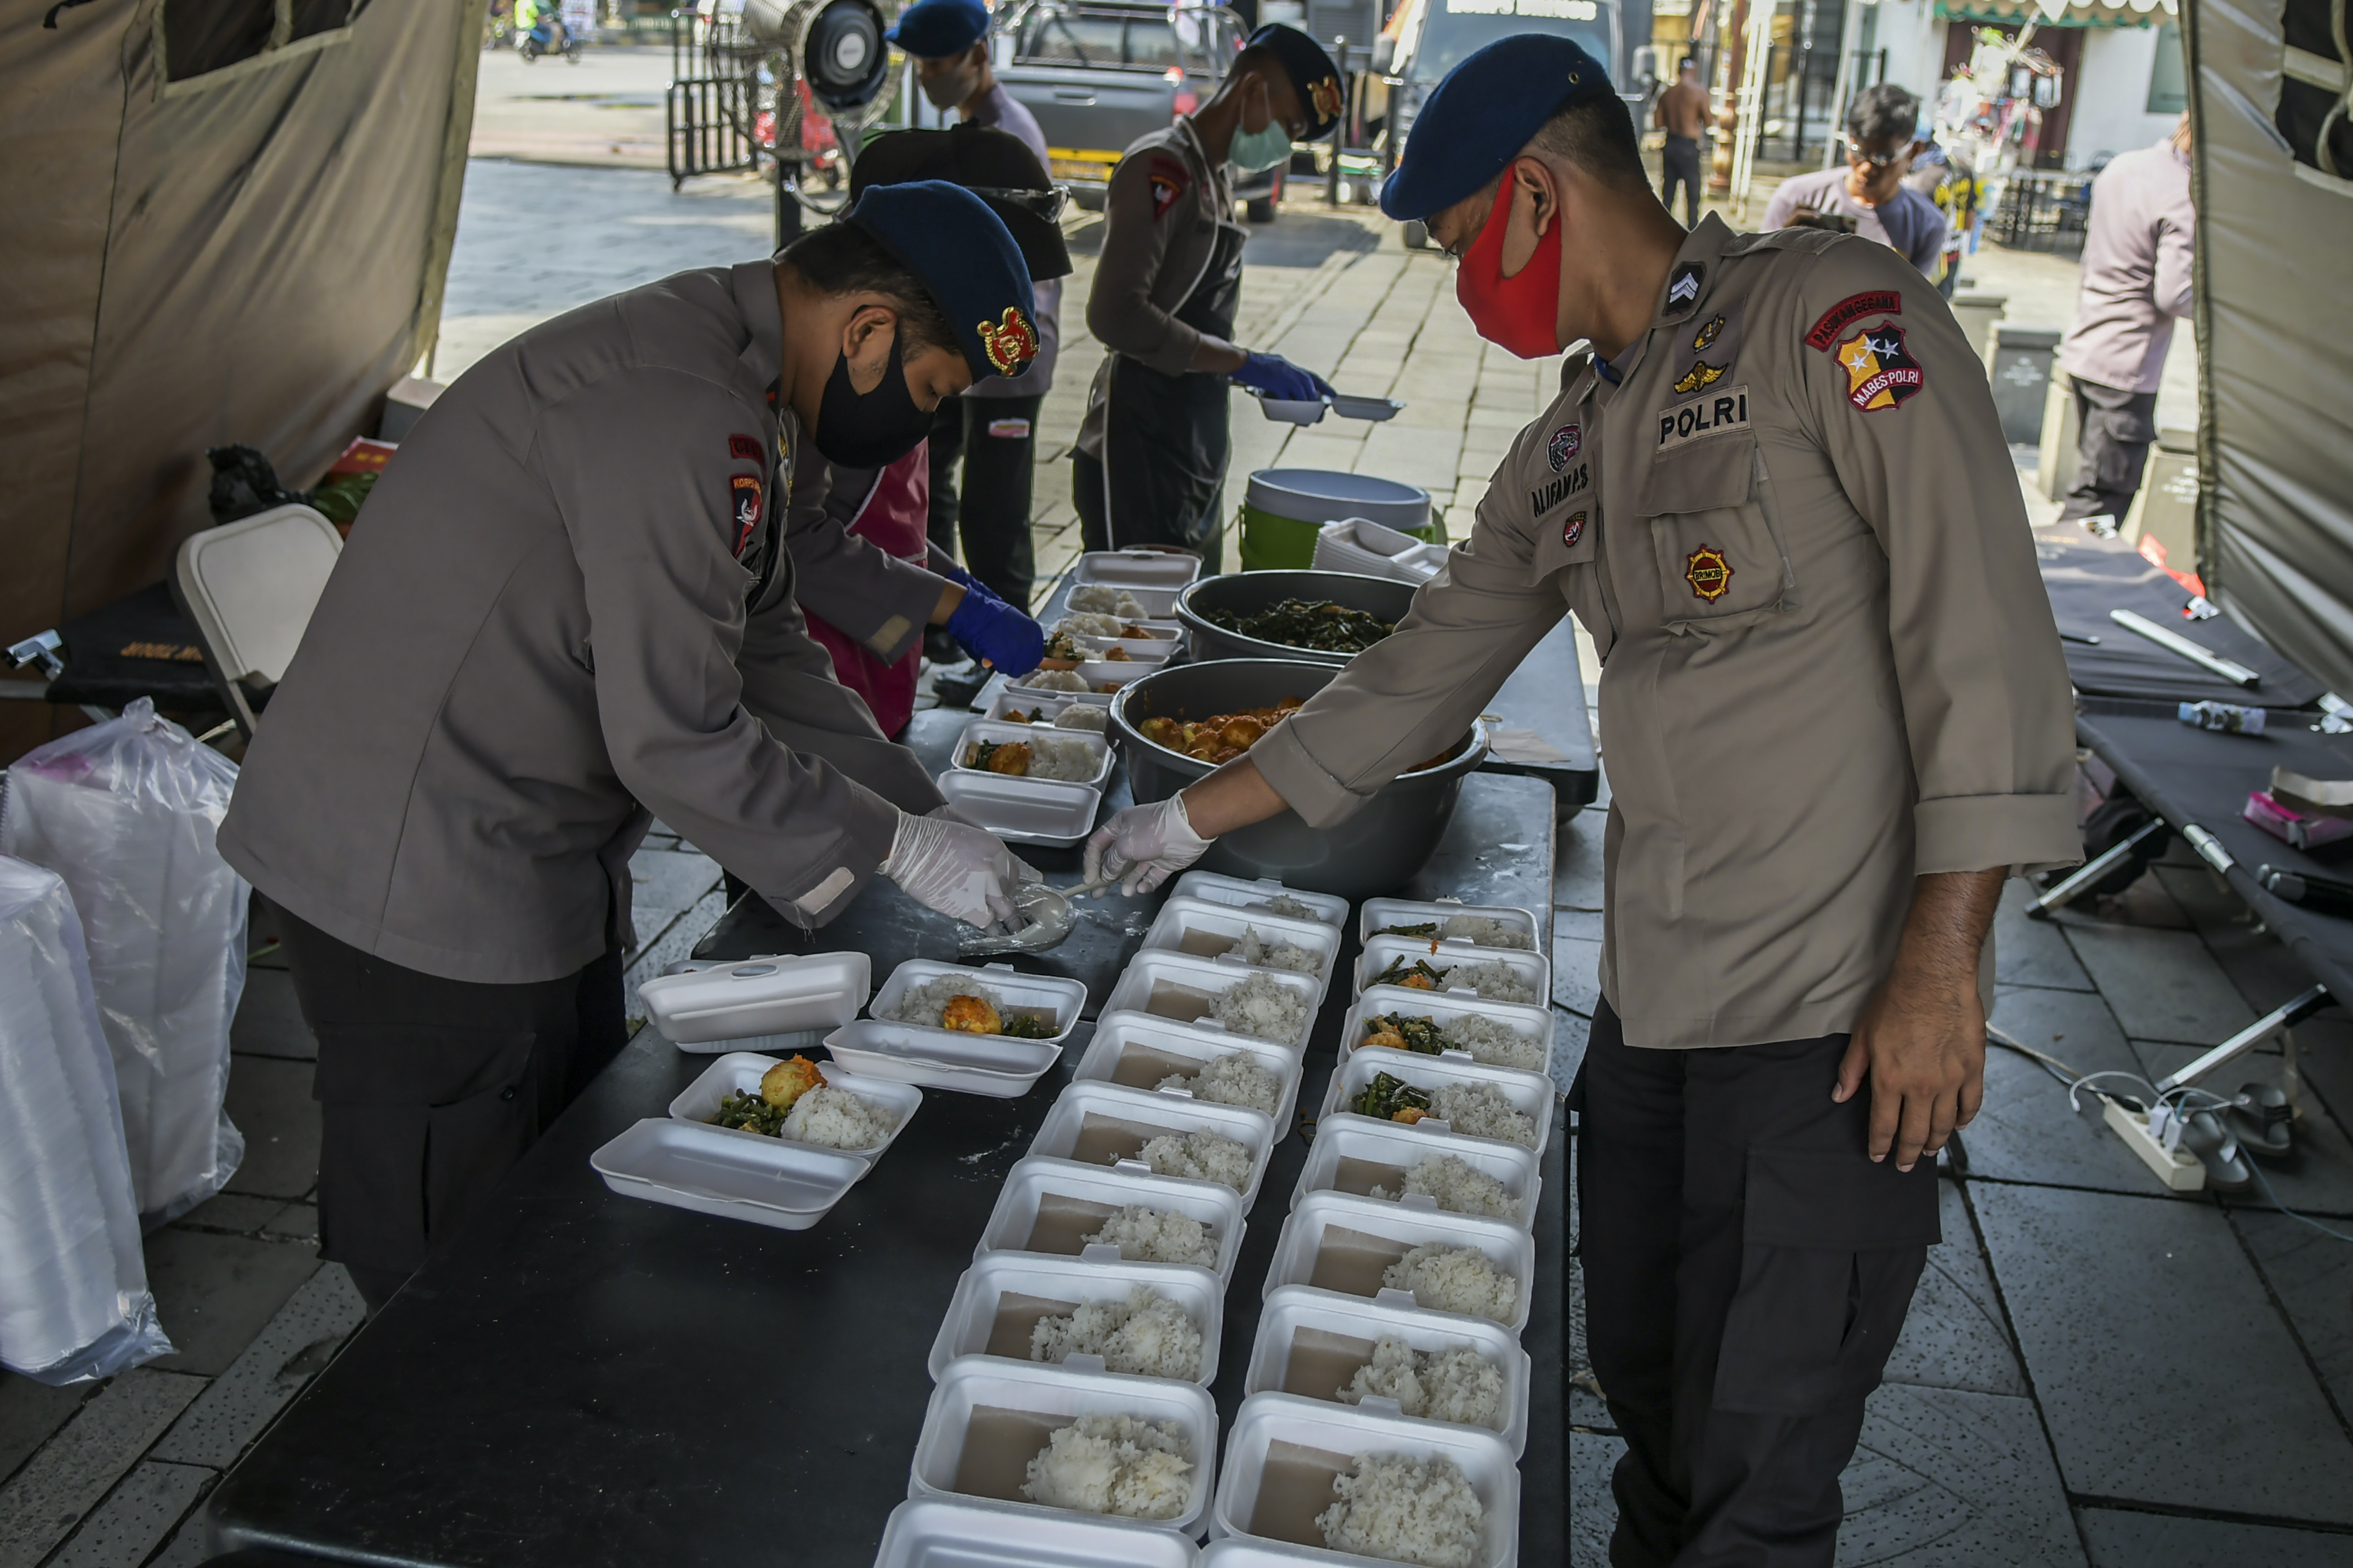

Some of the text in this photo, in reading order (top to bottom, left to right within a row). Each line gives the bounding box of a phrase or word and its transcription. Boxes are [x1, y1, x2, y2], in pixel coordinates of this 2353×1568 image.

[1814, 296, 1895, 344] PASUKAN GEGANA
[1853, 369, 1919, 406] MABES POLRI
[1660, 394, 1747, 445] POLRI
[734, 478, 754, 489] KORPS
[1531, 473, 1572, 518] ALIFAN
[1694, 569, 1721, 580] BRIMOB
